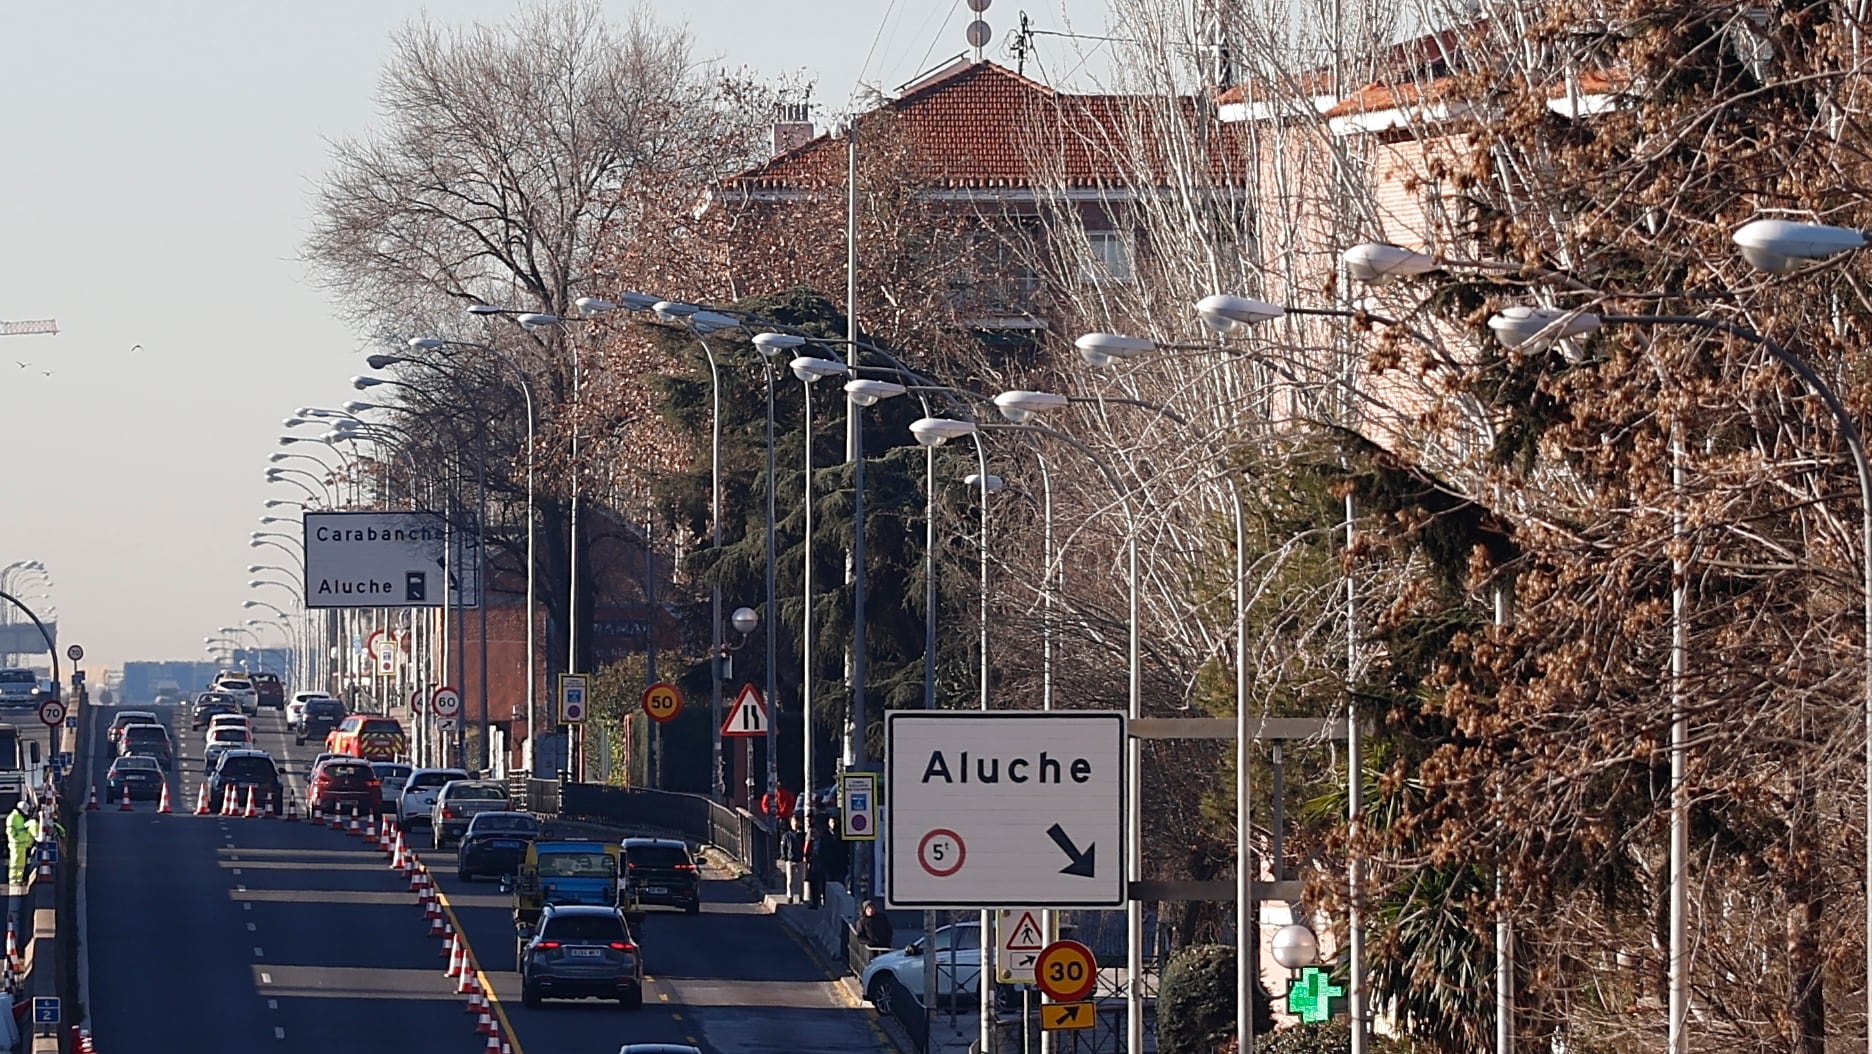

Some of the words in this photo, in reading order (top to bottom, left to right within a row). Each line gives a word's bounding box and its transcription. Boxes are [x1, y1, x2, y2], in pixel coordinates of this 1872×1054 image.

[318, 579, 392, 594] Aluche
[438, 697, 455, 708] 60
[651, 696, 673, 709] 50
[45, 709, 59, 718] 70
[922, 751, 1092, 784] Aluche
[1050, 961, 1084, 982] 30
[42, 1010, 51, 1020] 2
